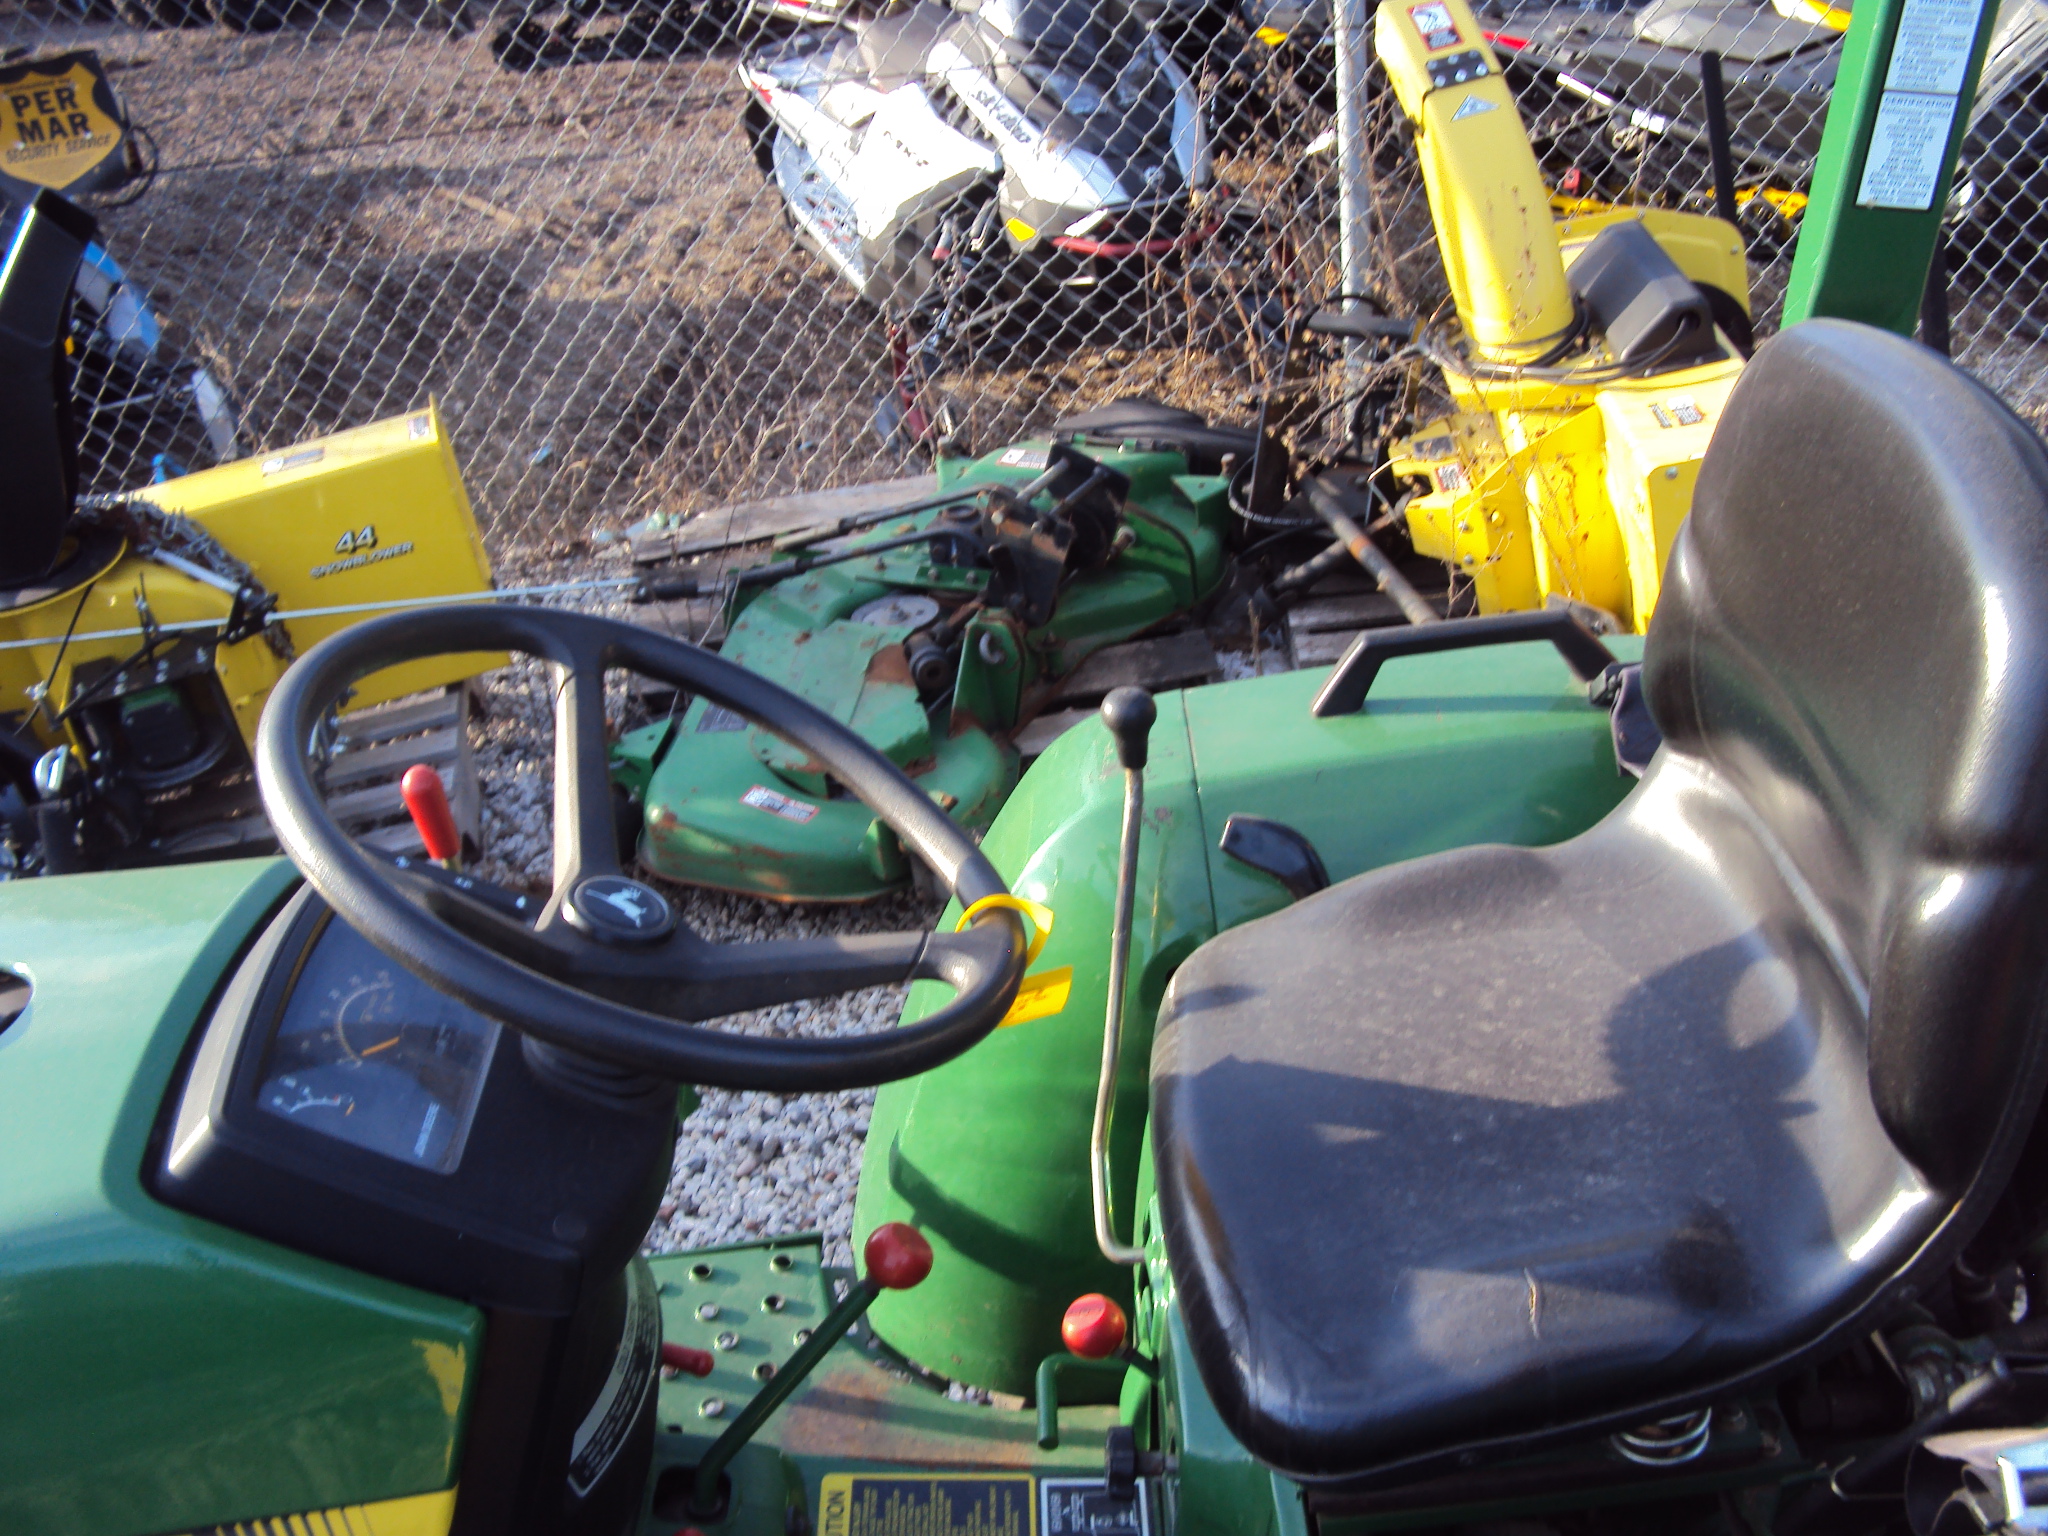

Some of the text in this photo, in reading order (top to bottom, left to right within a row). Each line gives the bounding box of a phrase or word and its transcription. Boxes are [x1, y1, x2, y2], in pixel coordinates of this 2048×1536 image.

[11, 86, 78, 118] PER
[17, 112, 91, 143] MAR
[6, 142, 59, 164] SECURITY
[66, 133, 111, 154] SERVICE
[335, 524, 378, 554] 44
[310, 541, 414, 579] SNOWBLOWER
[826, 1489, 845, 1536] TION
